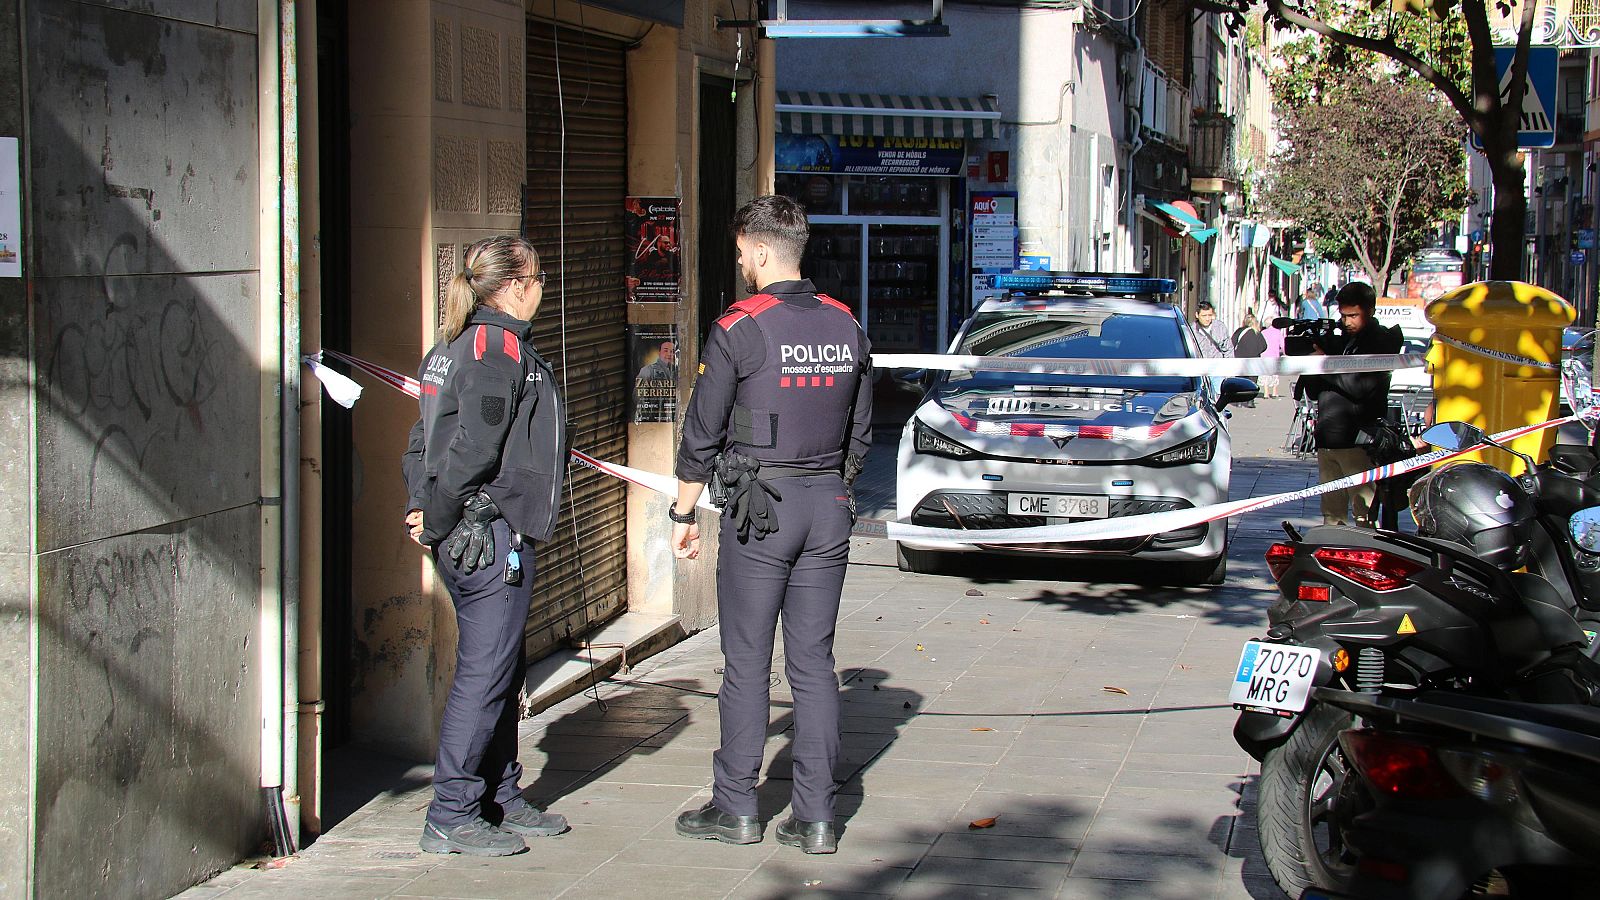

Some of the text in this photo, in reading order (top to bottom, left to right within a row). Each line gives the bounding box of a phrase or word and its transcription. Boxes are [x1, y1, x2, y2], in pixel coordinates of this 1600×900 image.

[780, 344, 854, 363] POLICIA
[781, 363, 853, 374] mossos d'esquadra
[1020, 496, 1100, 515] CME 3708
[1242, 667, 1250, 676] E
[1255, 648, 1313, 678] 7070
[1246, 675, 1290, 703] MRG
